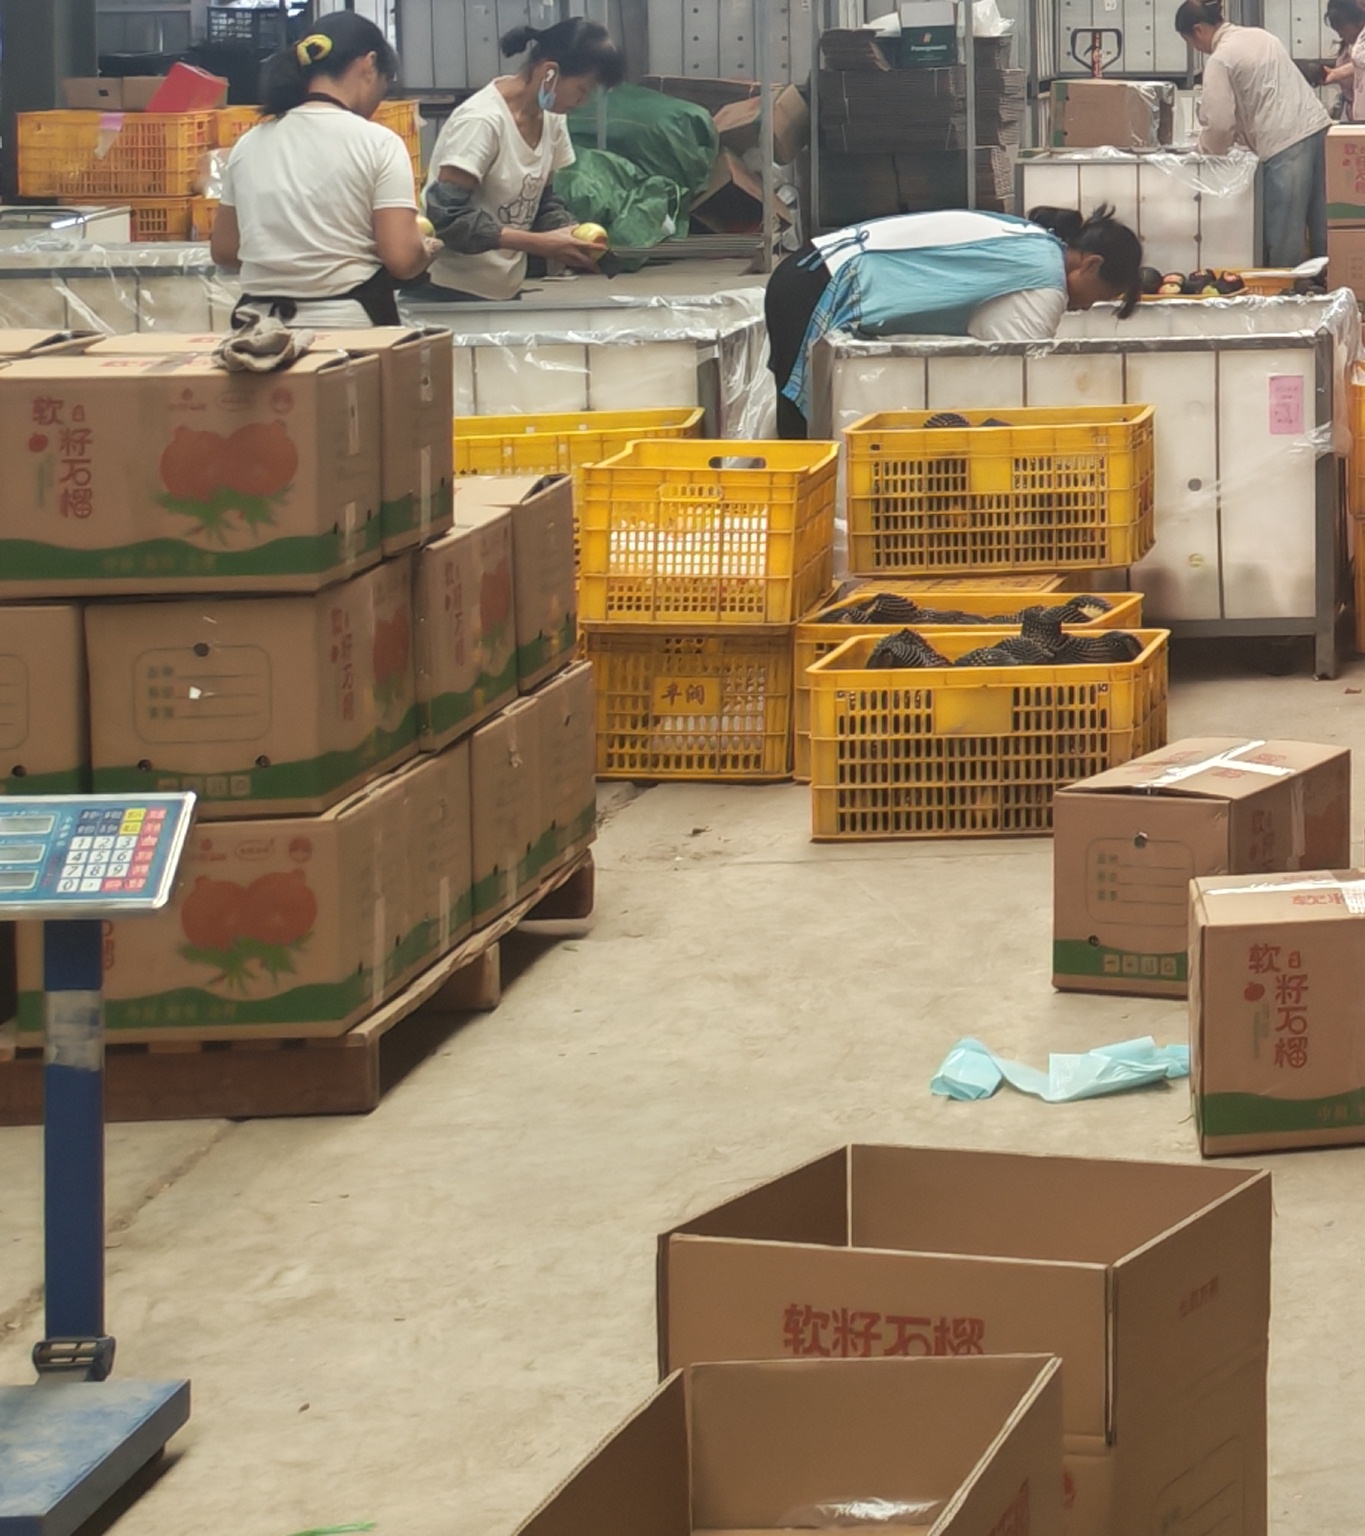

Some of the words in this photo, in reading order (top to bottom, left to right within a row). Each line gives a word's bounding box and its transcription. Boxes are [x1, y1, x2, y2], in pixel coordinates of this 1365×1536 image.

[33, 396, 94, 520] 软籽石榴
[1249, 943, 1309, 1068] 软籽石榴
[783, 1303, 986, 1357] 软籽石榴
